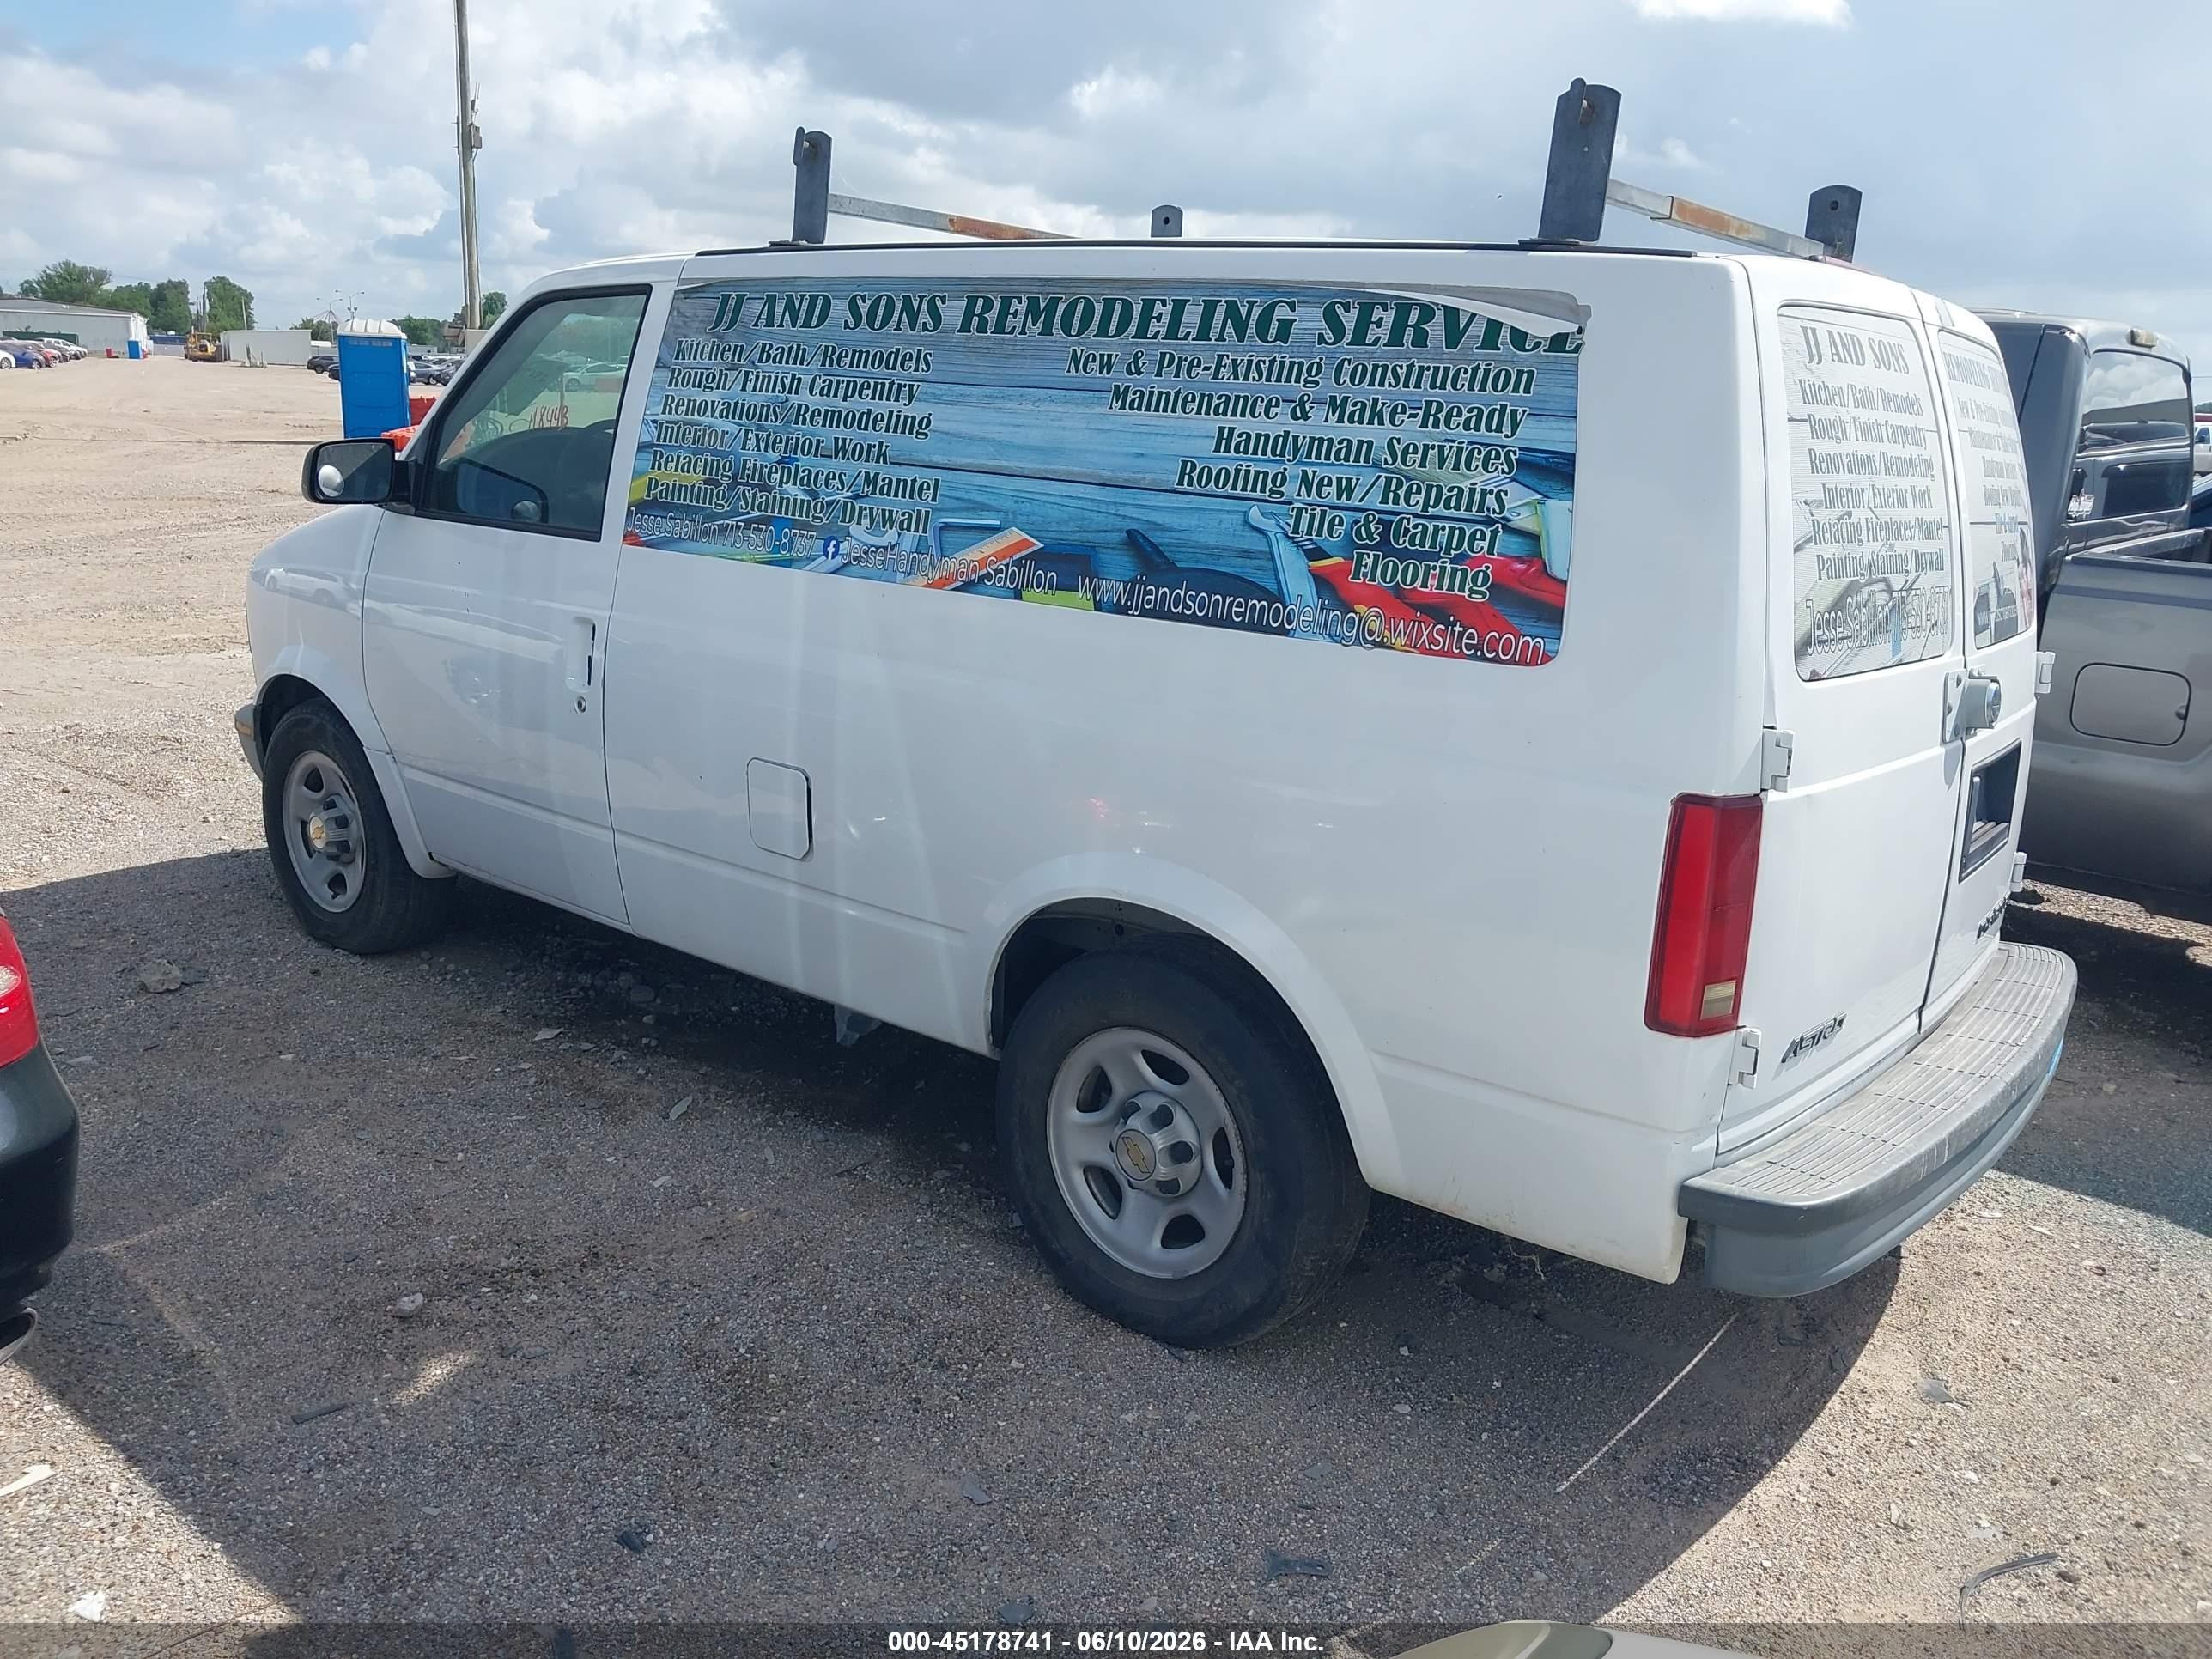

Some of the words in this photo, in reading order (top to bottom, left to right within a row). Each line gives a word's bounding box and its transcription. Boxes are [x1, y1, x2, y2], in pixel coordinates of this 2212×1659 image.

[708, 292, 750, 333] JJ
[752, 292, 833, 331] AND
[843, 293, 948, 336] SONS
[956, 295, 1297, 345] REMODELING
[672, 338, 933, 375] Kitchen/Bath/Remodels
[1065, 346, 1119, 376] New
[1124, 349, 1149, 377] &
[1157, 348, 1324, 388] Pre-Existing
[1334, 356, 1537, 396] Construction
[1800, 325, 1823, 365] JJ
[1826, 330, 1865, 366] AND
[1868, 337, 1910, 374] SONS
[666, 367, 805, 398] Rough/Finish
[807, 374, 921, 407] Carpentry
[1107, 384, 1282, 421] Maintenance
[1291, 392, 1315, 422] &
[1322, 394, 1528, 438] Make-Ready
[1798, 378, 1924, 416] Kitchen/Bath/Remodels
[659, 394, 933, 440] Renovations/Remodeling
[1807, 413, 1884, 444] Rough/Finish
[1885, 419, 1927, 450] Carpentry
[654, 421, 826, 459] Interior/Exterior
[831, 438, 893, 466] Work
[1211, 424, 1375, 465] Handyman
[1382, 435, 1518, 476] Services
[1807, 447, 1936, 481] Renovations/Remodeling
[648, 448, 736, 482] Refacing
[738, 457, 941, 505] Fireplaces/Mantel
[1175, 458, 1288, 498] Roofing
[1297, 468, 1510, 517] New/Repairs
[1822, 483, 1909, 509] Interior/Exterior
[1910, 484, 1933, 509] Work
[644, 477, 933, 536] Painting/Staining/Drywall
[1287, 504, 1345, 540] Tile
[1355, 512, 1382, 544] &
[1390, 514, 1502, 556] Carpet
[627, 507, 663, 536] Jesse
[665, 512, 719, 546] Sabillon
[722, 520, 818, 558] 713-530-8737
[842, 536, 980, 585] JesseHandyman
[983, 555, 1058, 595] Sabillon
[1811, 517, 1863, 546] Refacing
[1866, 517, 1943, 545] Fireplaces/Mantel
[1349, 550, 1492, 601] Flooring
[1816, 549, 1944, 581] Painting/Staining/Drywall
[1805, 599, 1844, 657] Jesse
